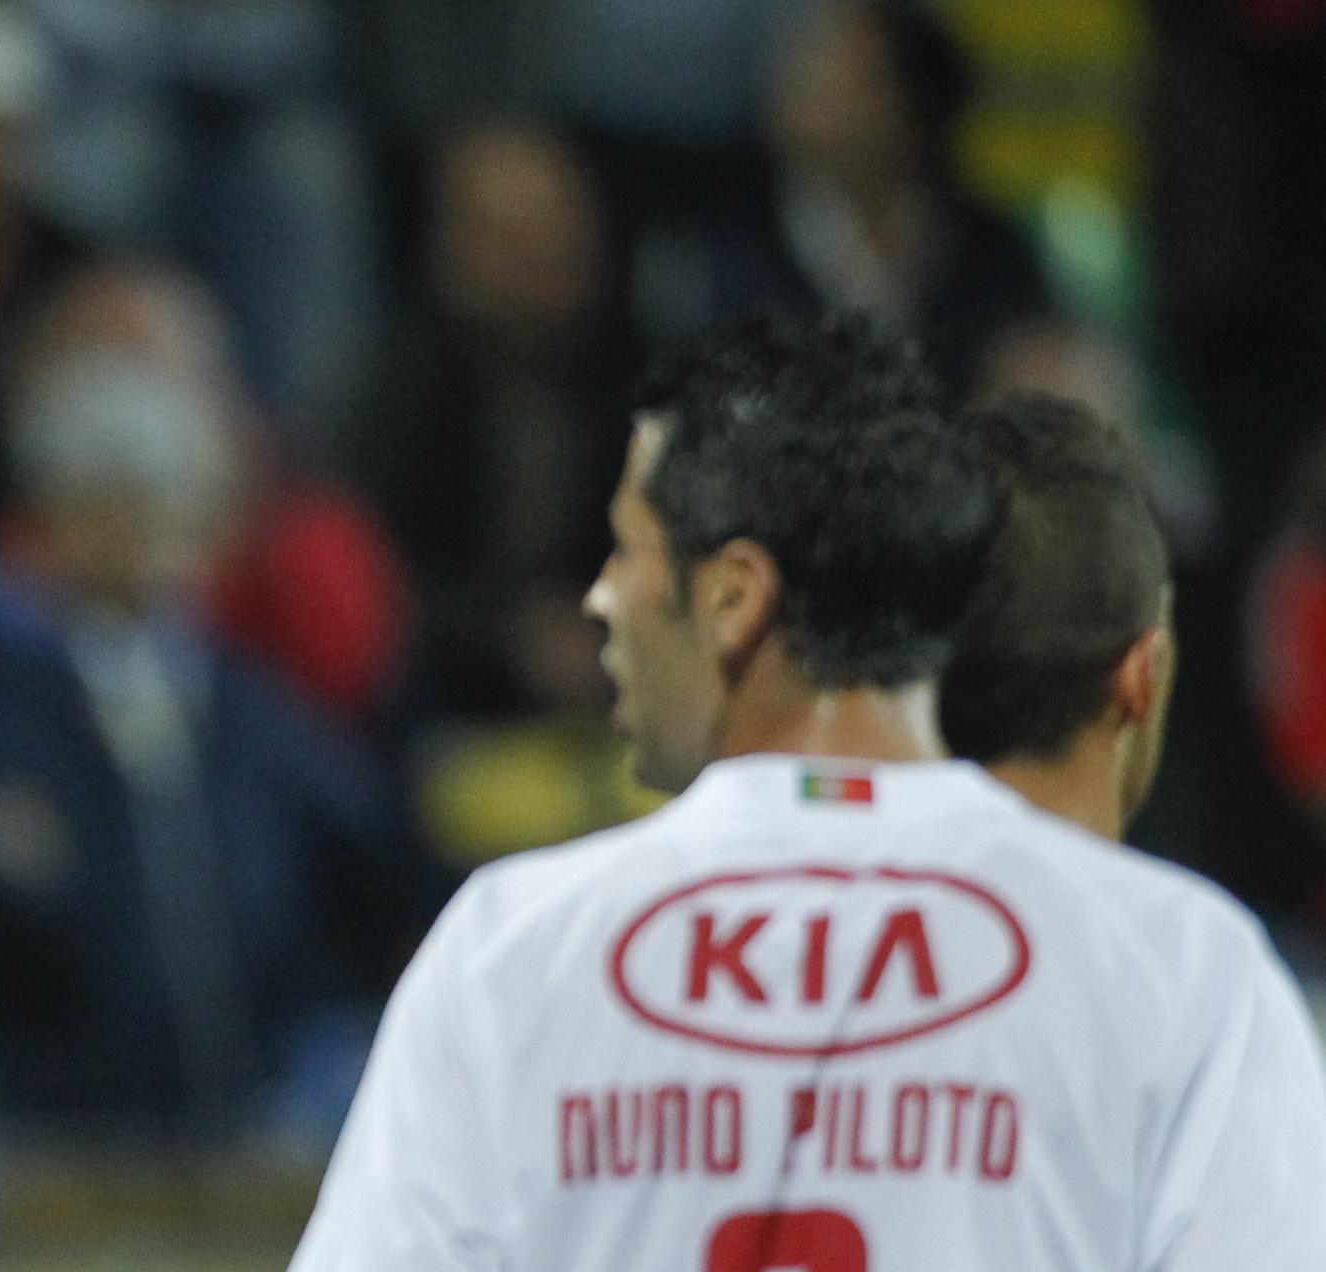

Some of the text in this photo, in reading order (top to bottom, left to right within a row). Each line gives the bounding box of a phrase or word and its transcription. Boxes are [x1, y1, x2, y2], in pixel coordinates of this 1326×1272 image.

[685, 908, 940, 1006] KIA
[558, 1081, 1020, 1185] NUNO PILOTO
